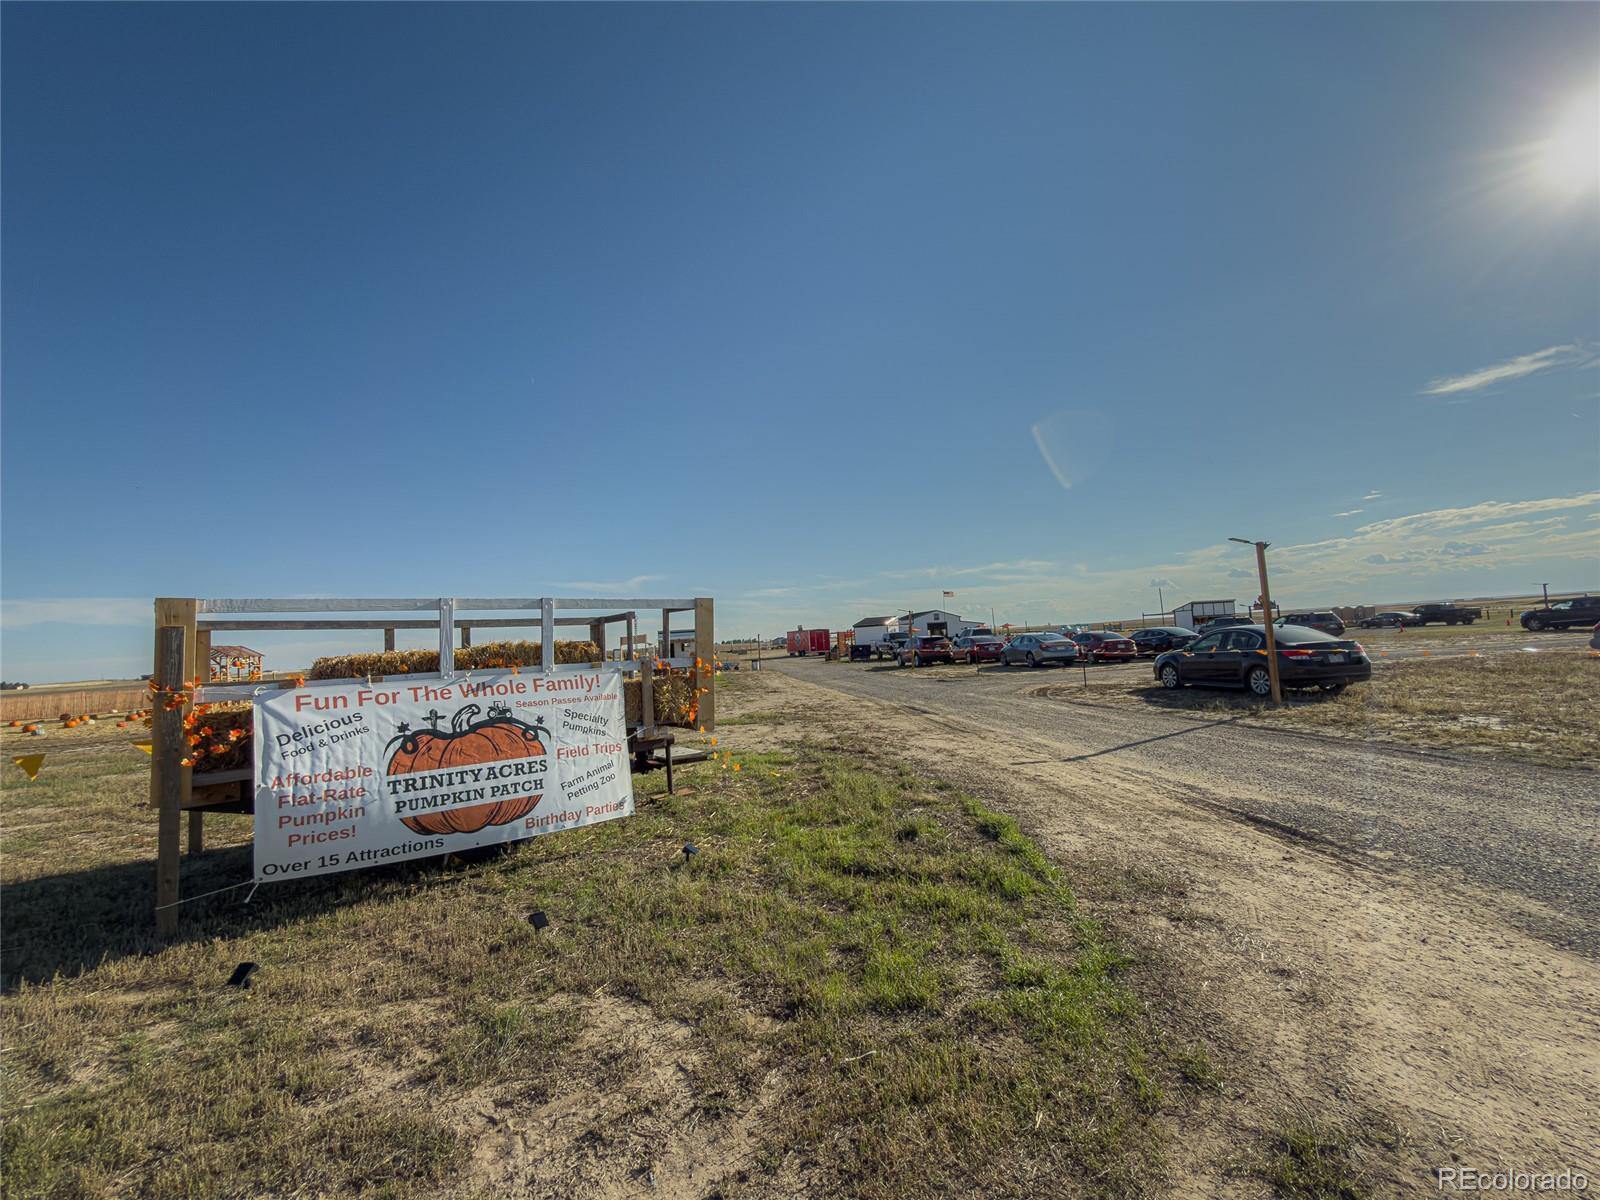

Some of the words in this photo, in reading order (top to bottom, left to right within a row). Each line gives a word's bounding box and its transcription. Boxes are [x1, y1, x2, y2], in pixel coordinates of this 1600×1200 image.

[295, 694, 348, 712] Fun
[357, 691, 400, 706] For
[408, 686, 453, 703] The
[459, 681, 526, 699] Whole
[533, 675, 600, 694] Family!
[515, 699, 550, 709] Season
[551, 696, 582, 706] Passes
[583, 692, 619, 702] Available
[276, 713, 363, 746] Delicious
[562, 721, 607, 737] Pumpkins
[563, 708, 609, 727] Specialty
[280, 743, 316, 761] Food
[318, 737, 328, 748] &
[330, 724, 370, 744] Drinks
[556, 744, 590, 760] Field
[592, 741, 622, 756] Trips
[272, 766, 372, 789] Affordable
[387, 767, 485, 795] TRINITY
[486, 759, 549, 780] ACRES
[560, 775, 587, 791] Farm
[586, 760, 615, 779] Animal
[567, 781, 598, 801] Petting
[596, 772, 617, 787] Zoo
[277, 785, 366, 809] Flat-Rate
[394, 788, 486, 814] PUMPKIN
[490, 778, 545, 798] PATCH
[278, 805, 366, 829] Pumpkin
[524, 809, 583, 830] Birthday
[585, 799, 626, 816] Parties
[287, 825, 356, 848] Prices!
[262, 860, 312, 877] Over
[317, 852, 341, 868] 15
[345, 837, 445, 864] Attractions
